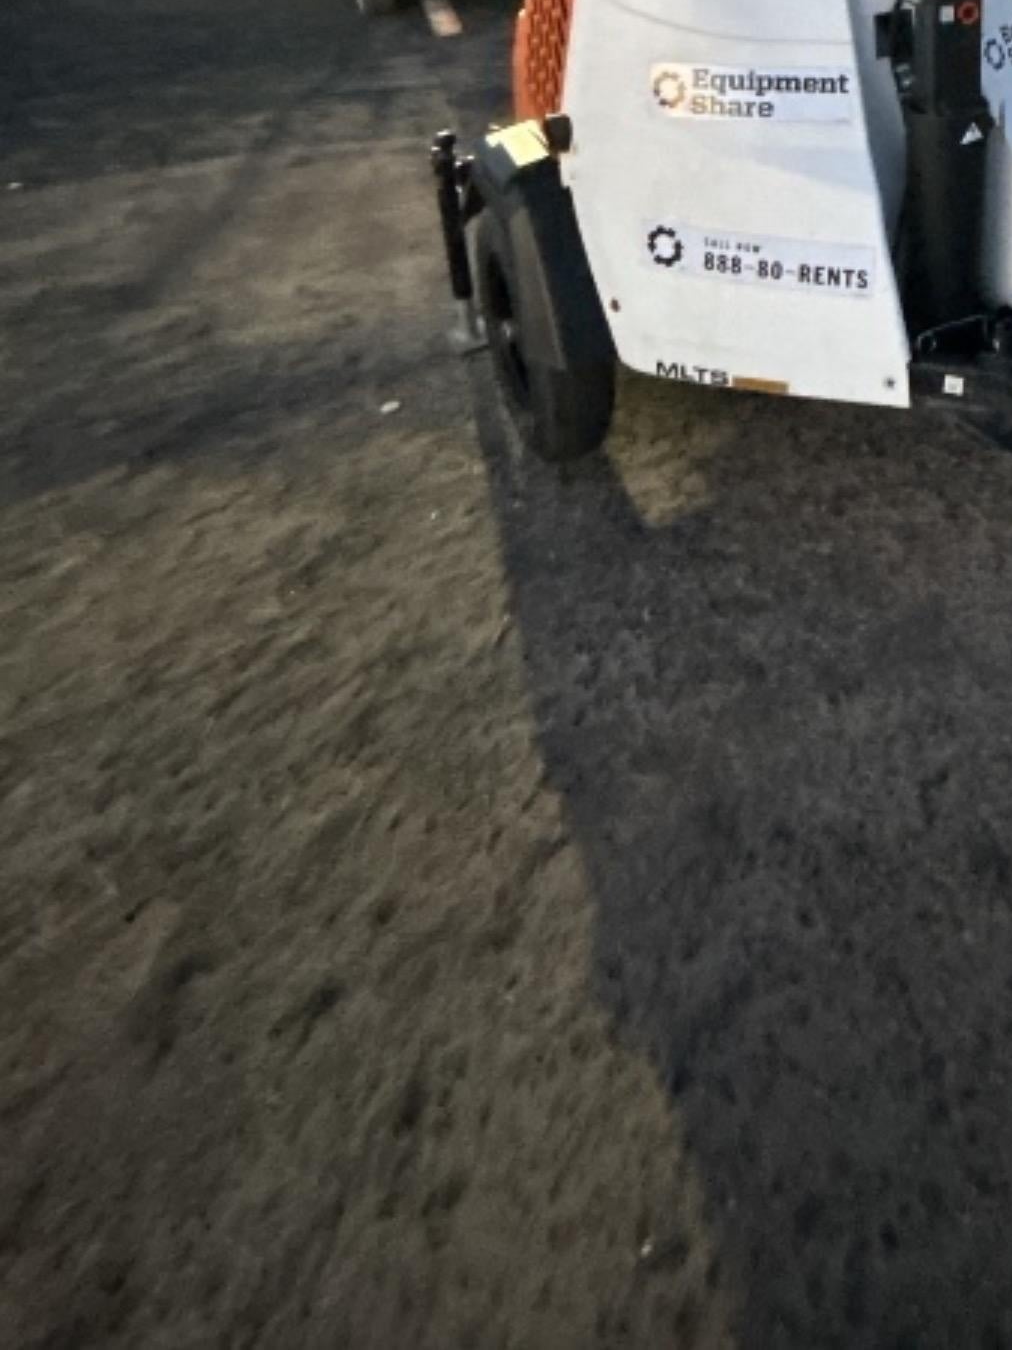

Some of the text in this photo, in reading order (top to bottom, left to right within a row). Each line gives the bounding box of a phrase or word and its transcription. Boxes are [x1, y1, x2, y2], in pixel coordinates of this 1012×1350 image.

[691, 68, 849, 96] Equipment
[690, 94, 774, 118] Share
[704, 251, 869, 290] 888-80-RENTS
